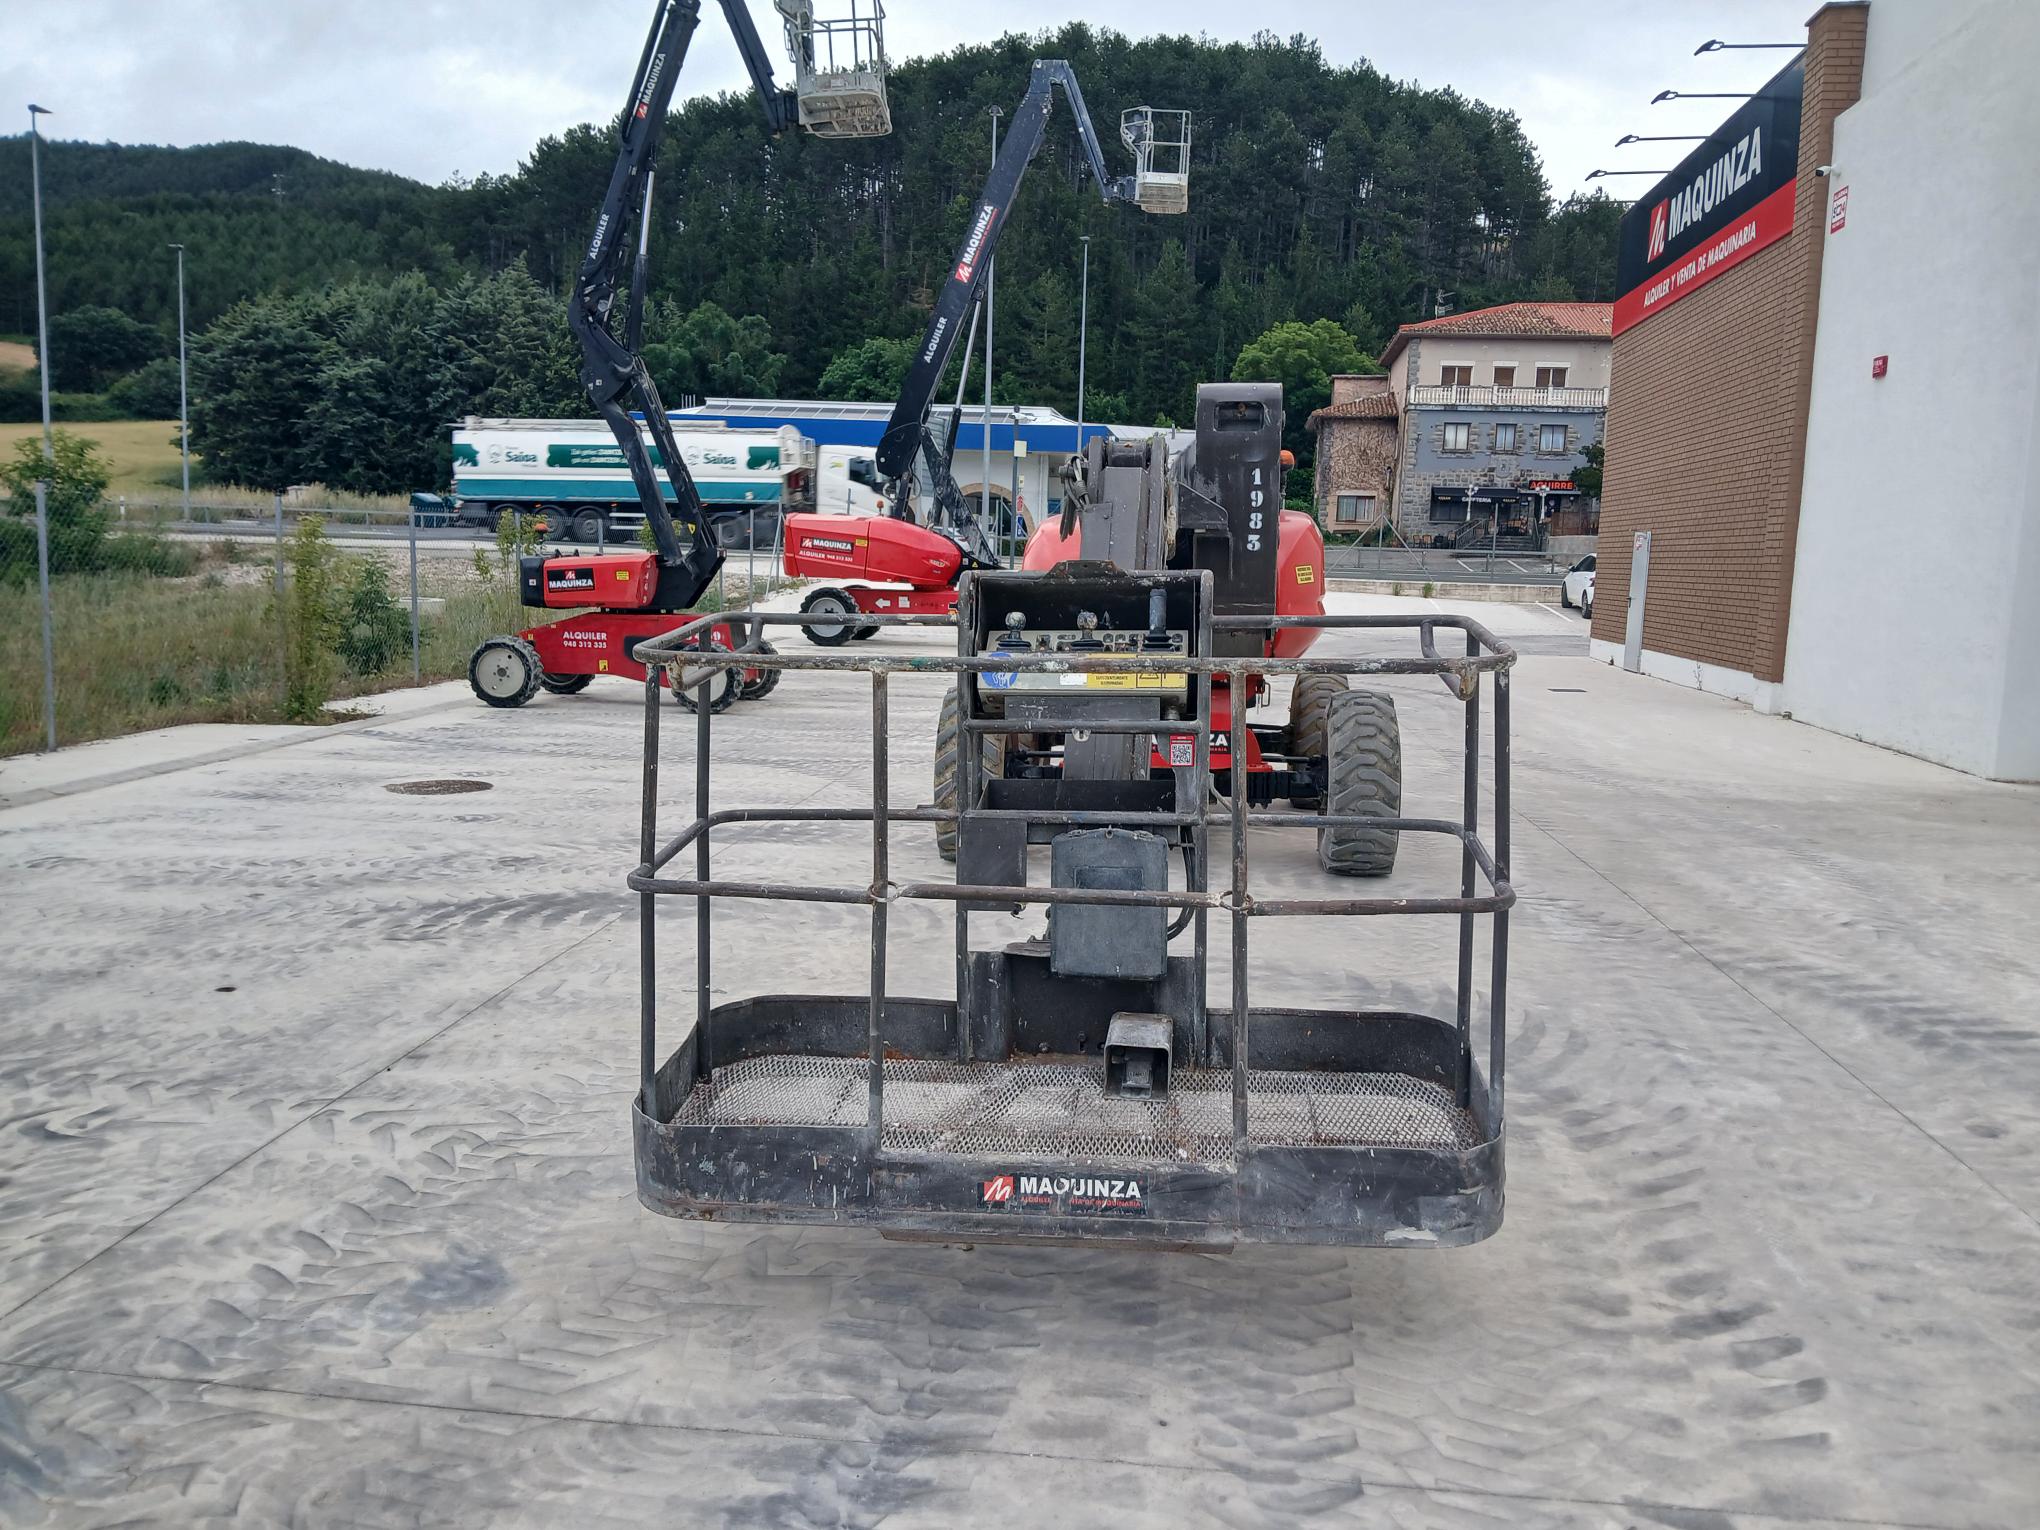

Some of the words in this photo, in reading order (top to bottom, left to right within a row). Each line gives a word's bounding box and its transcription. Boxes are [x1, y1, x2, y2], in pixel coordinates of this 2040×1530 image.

[642, 53, 666, 104] MAQUINZA
[1668, 126, 1762, 241] MAQUINZA
[589, 213, 610, 260] ALQUILER
[962, 205, 994, 265] MAQUINZA
[1643, 277, 1670, 309] ALQUILER
[1676, 261, 1697, 286] VENTA
[1697, 255, 1707, 274] DE
[1706, 221, 1756, 269] MAQUINARIA
[923, 316, 948, 364] ALQUILER
[799, 550, 826, 559] ALQUILER
[813, 538, 852, 551] MAQUINZA
[549, 579, 594, 589] MAQUINZA
[563, 631, 607, 640] ALQUILER
[1020, 1176, 1142, 1199] MAQUINZA
